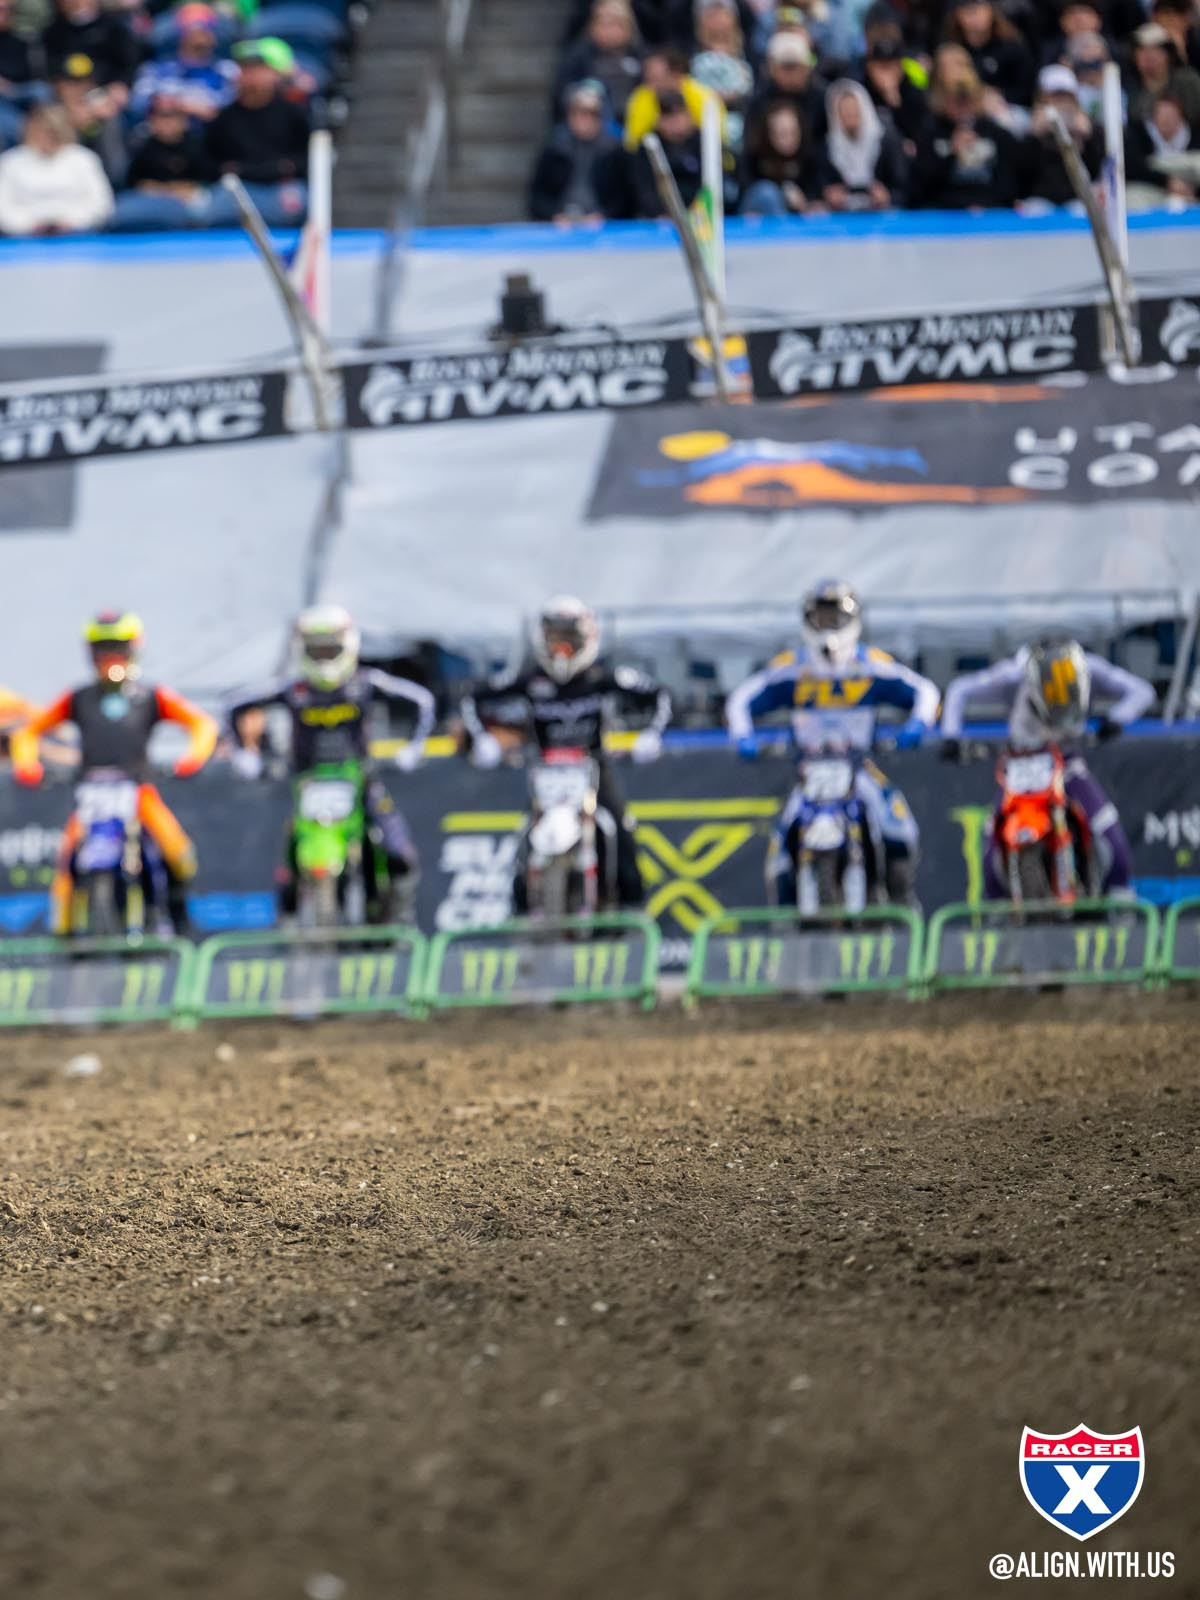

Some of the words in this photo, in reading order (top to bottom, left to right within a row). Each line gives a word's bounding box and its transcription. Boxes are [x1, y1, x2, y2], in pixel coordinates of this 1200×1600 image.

[818, 322, 915, 351] ROCKY
[917, 308, 1075, 346] MOUNTAIN
[506, 342, 666, 378] MOUNTAIN
[795, 679, 873, 707] FLY
